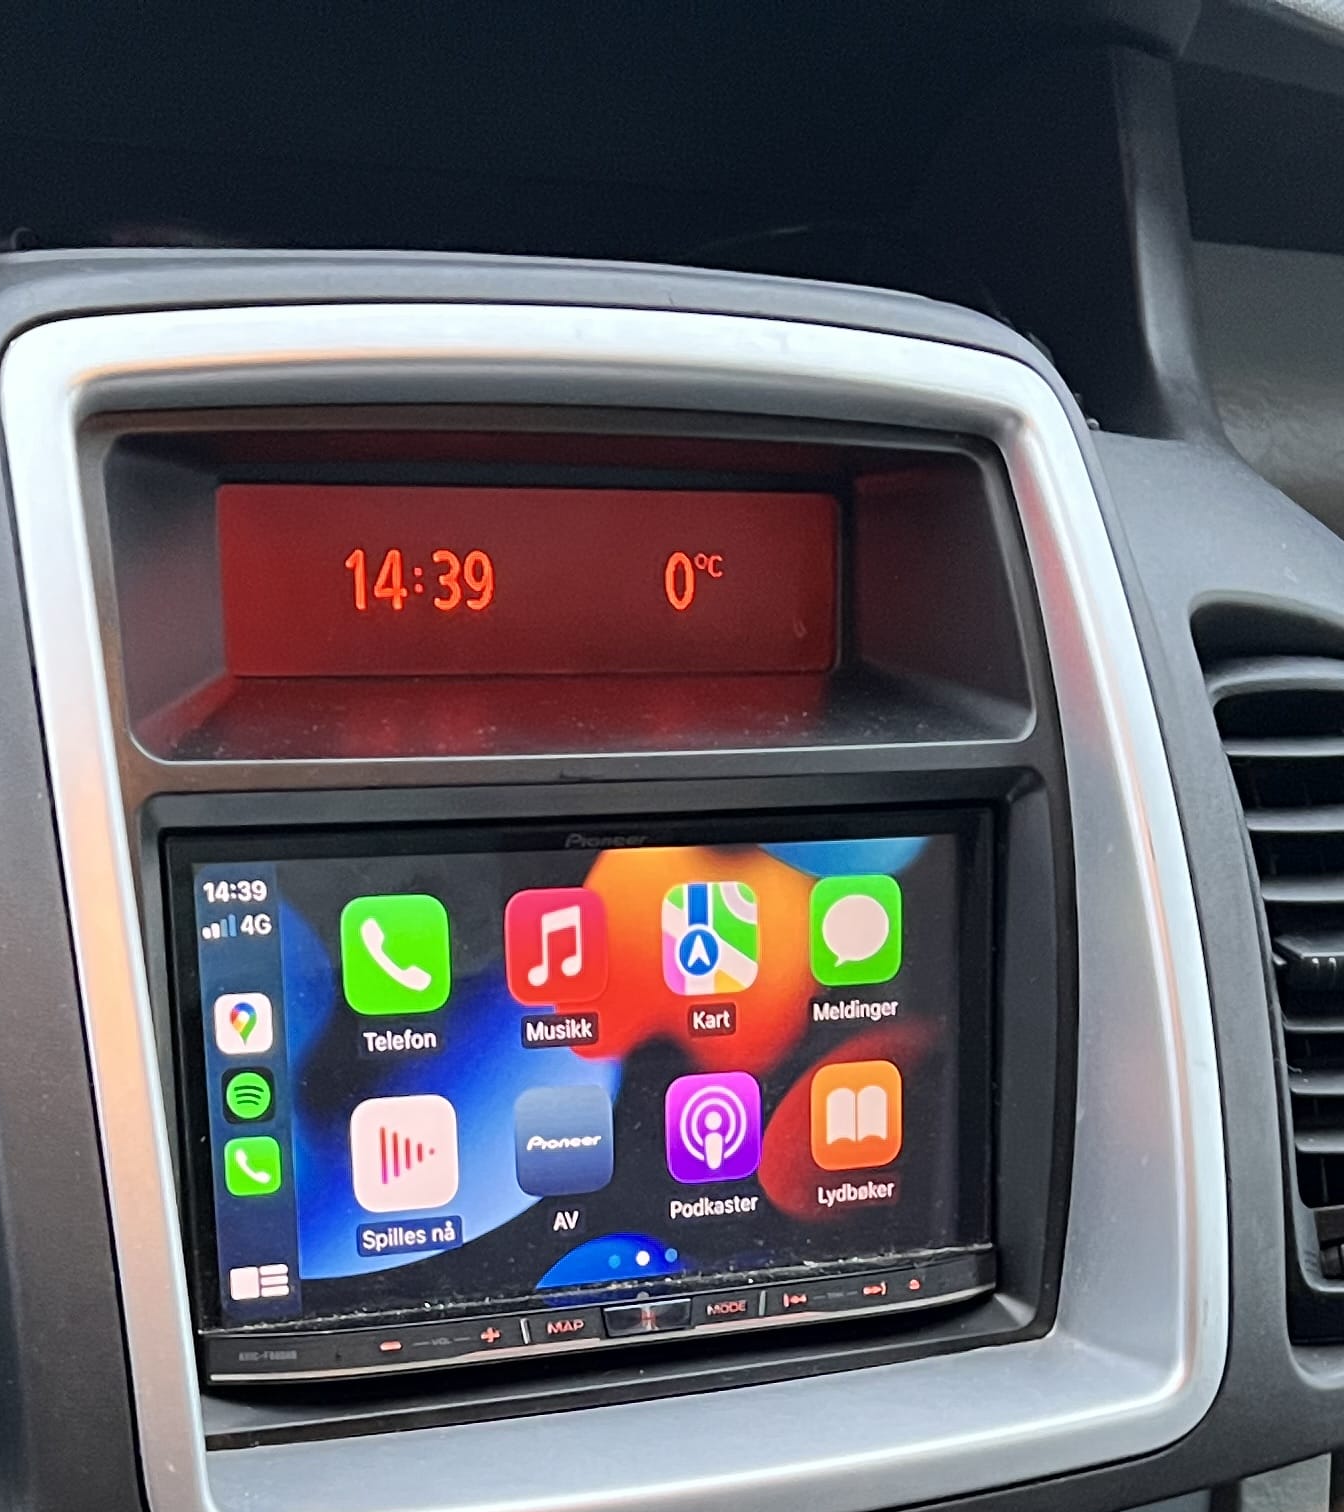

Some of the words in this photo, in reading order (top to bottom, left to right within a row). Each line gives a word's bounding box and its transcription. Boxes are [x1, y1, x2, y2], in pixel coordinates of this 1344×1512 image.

[344, 548, 496, 611] 14:39
[202, 879, 268, 903] 14:39
[240, 913, 273, 937] 4G
[692, 1009, 731, 1031] Kart
[812, 999, 899, 1022] Meldinger
[362, 1028, 438, 1053] Telefon
[525, 1019, 594, 1043] Musikk
[526, 1134, 603, 1152] Pioneer
[817, 1181, 896, 1207] Lydbøker
[670, 1195, 760, 1220] Podkaster
[552, 1210, 580, 1232] AV
[362, 1227, 427, 1253] Spilles
[430, 1220, 457, 1244] nå
[707, 1300, 747, 1316] MODE
[547, 1319, 585, 1335] MAP
